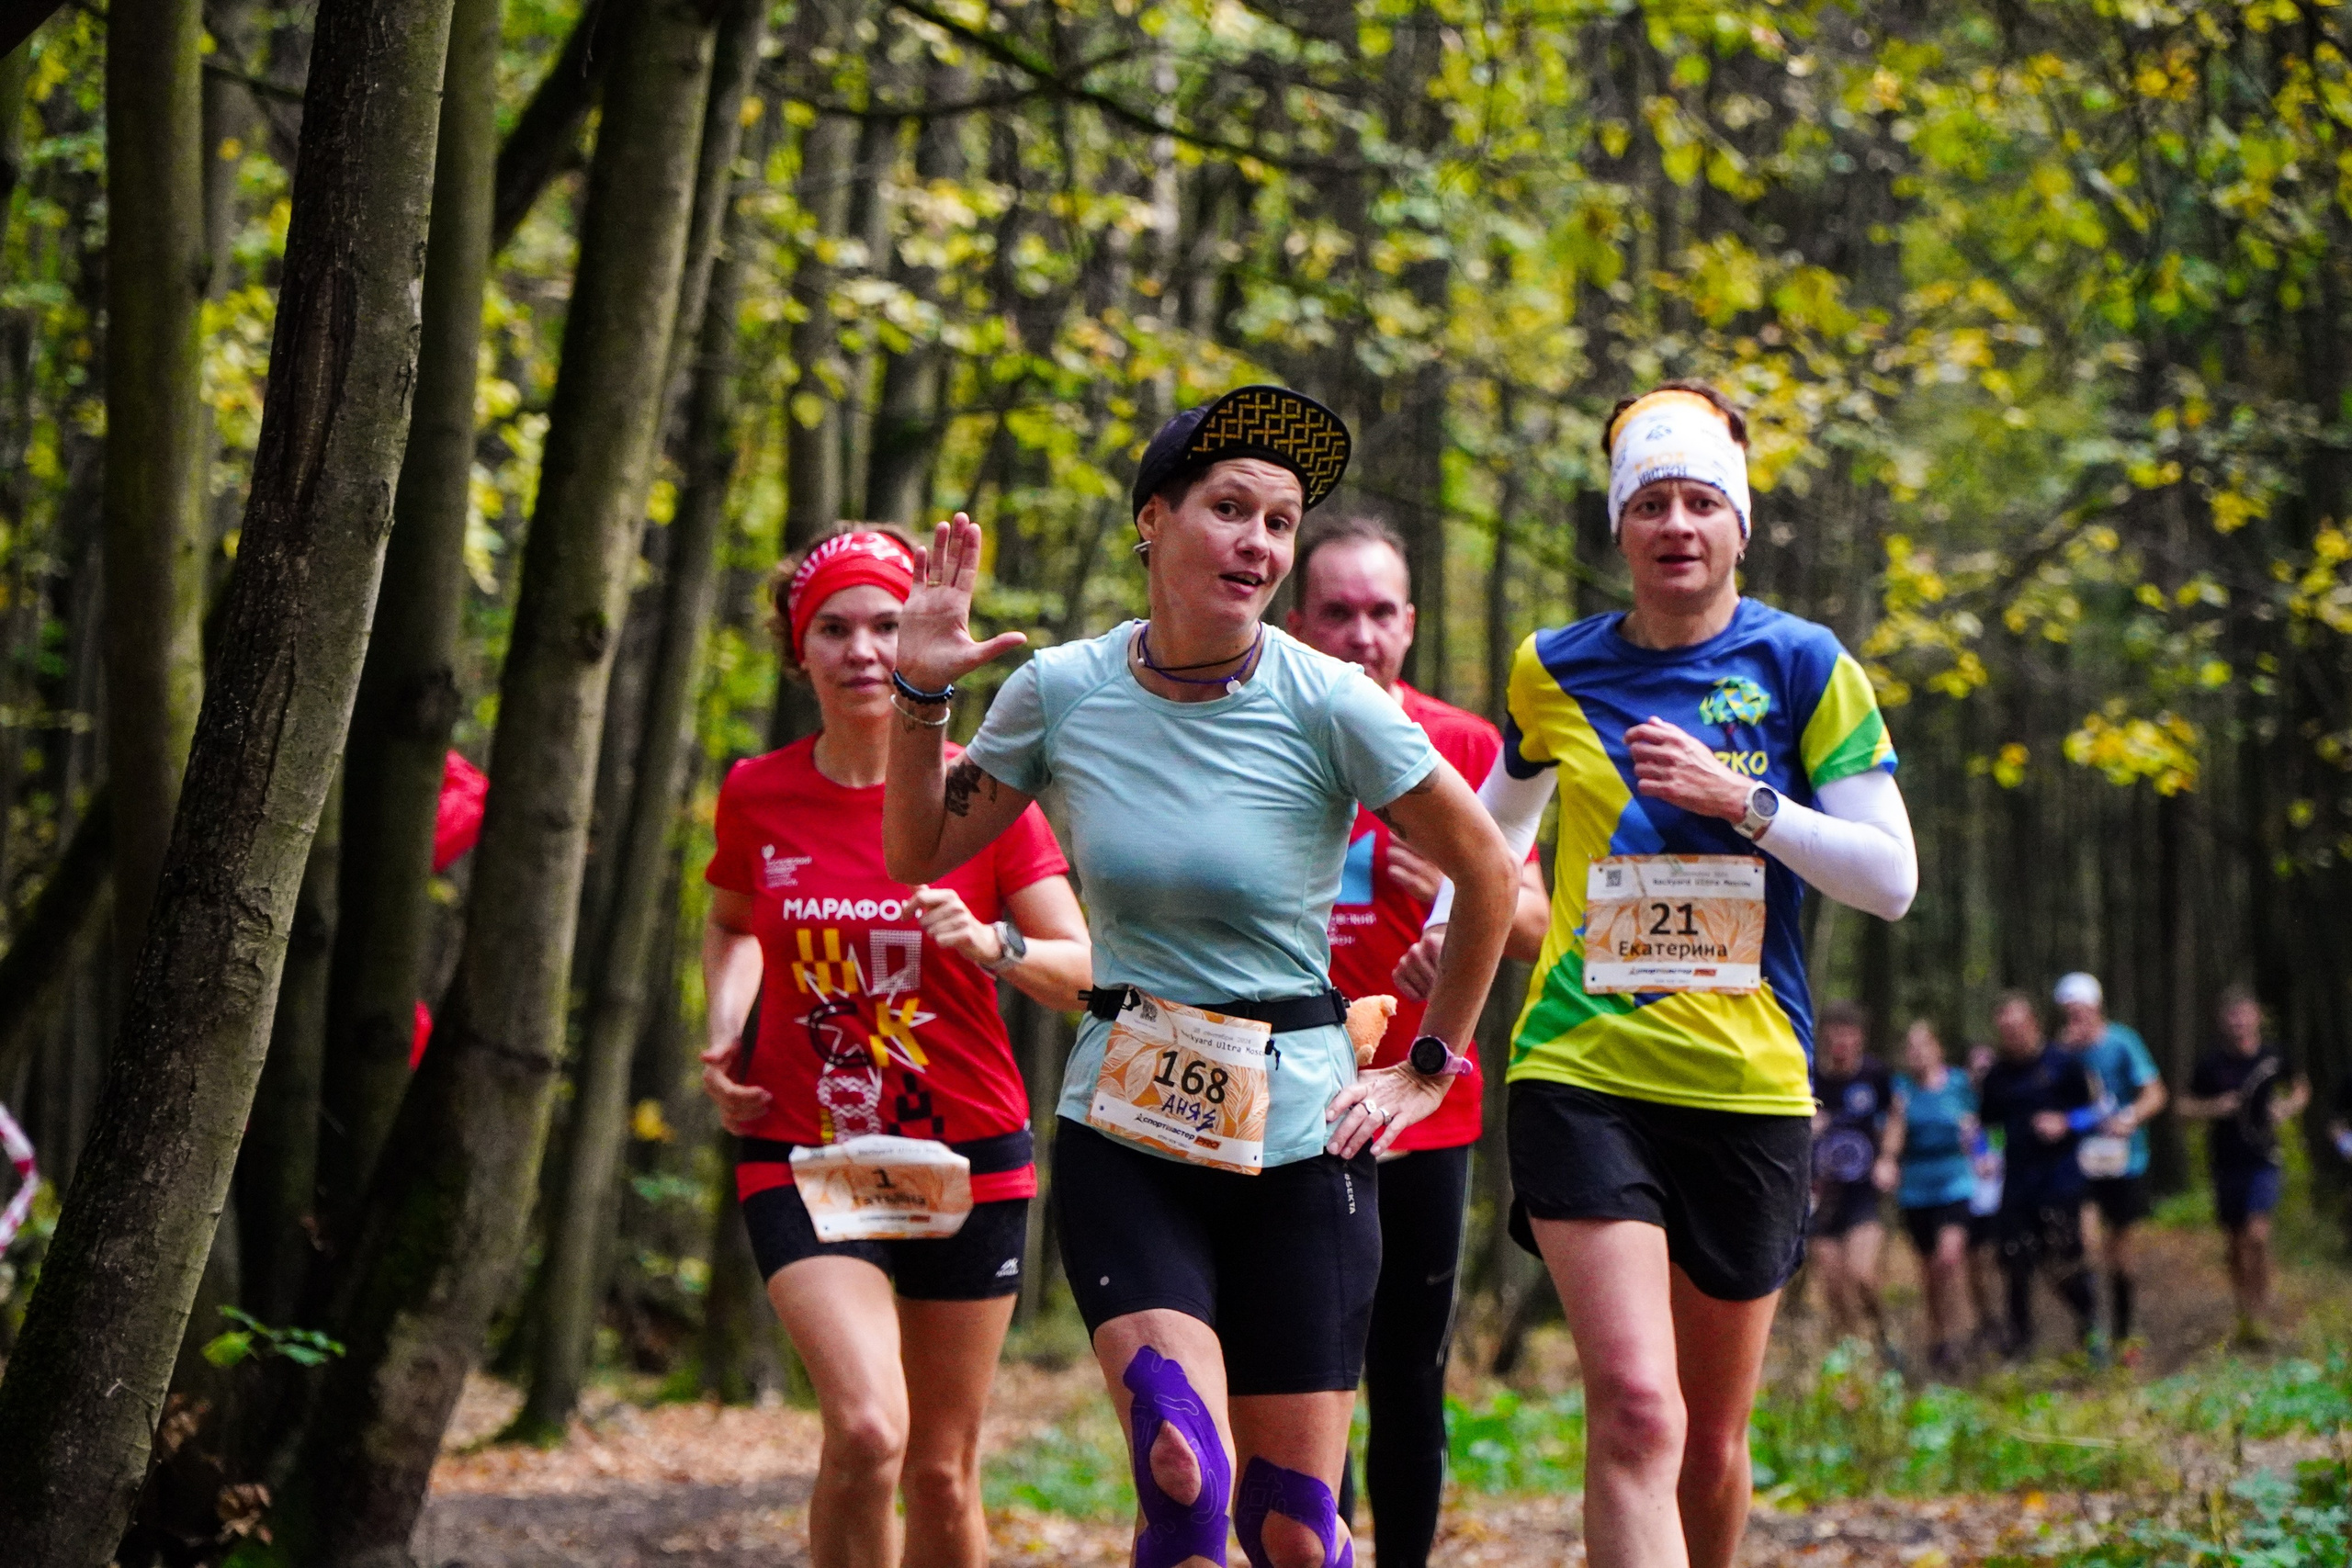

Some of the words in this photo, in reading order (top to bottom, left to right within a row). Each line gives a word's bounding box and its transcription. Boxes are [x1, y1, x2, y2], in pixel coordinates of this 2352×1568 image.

[783, 897, 922, 921] МАРАФО
[1649, 902, 1698, 935] 21
[1619, 941, 1727, 959] Екатерина
[1216, 1040, 1242, 1053] Ultra
[1245, 1047, 1266, 1057] Mosc
[1153, 1050, 1228, 1104] 168
[1161, 1094, 1201, 1121] АНЯ
[1194, 1136, 1219, 1150] PRO
[872, 1168, 897, 1189] 1
